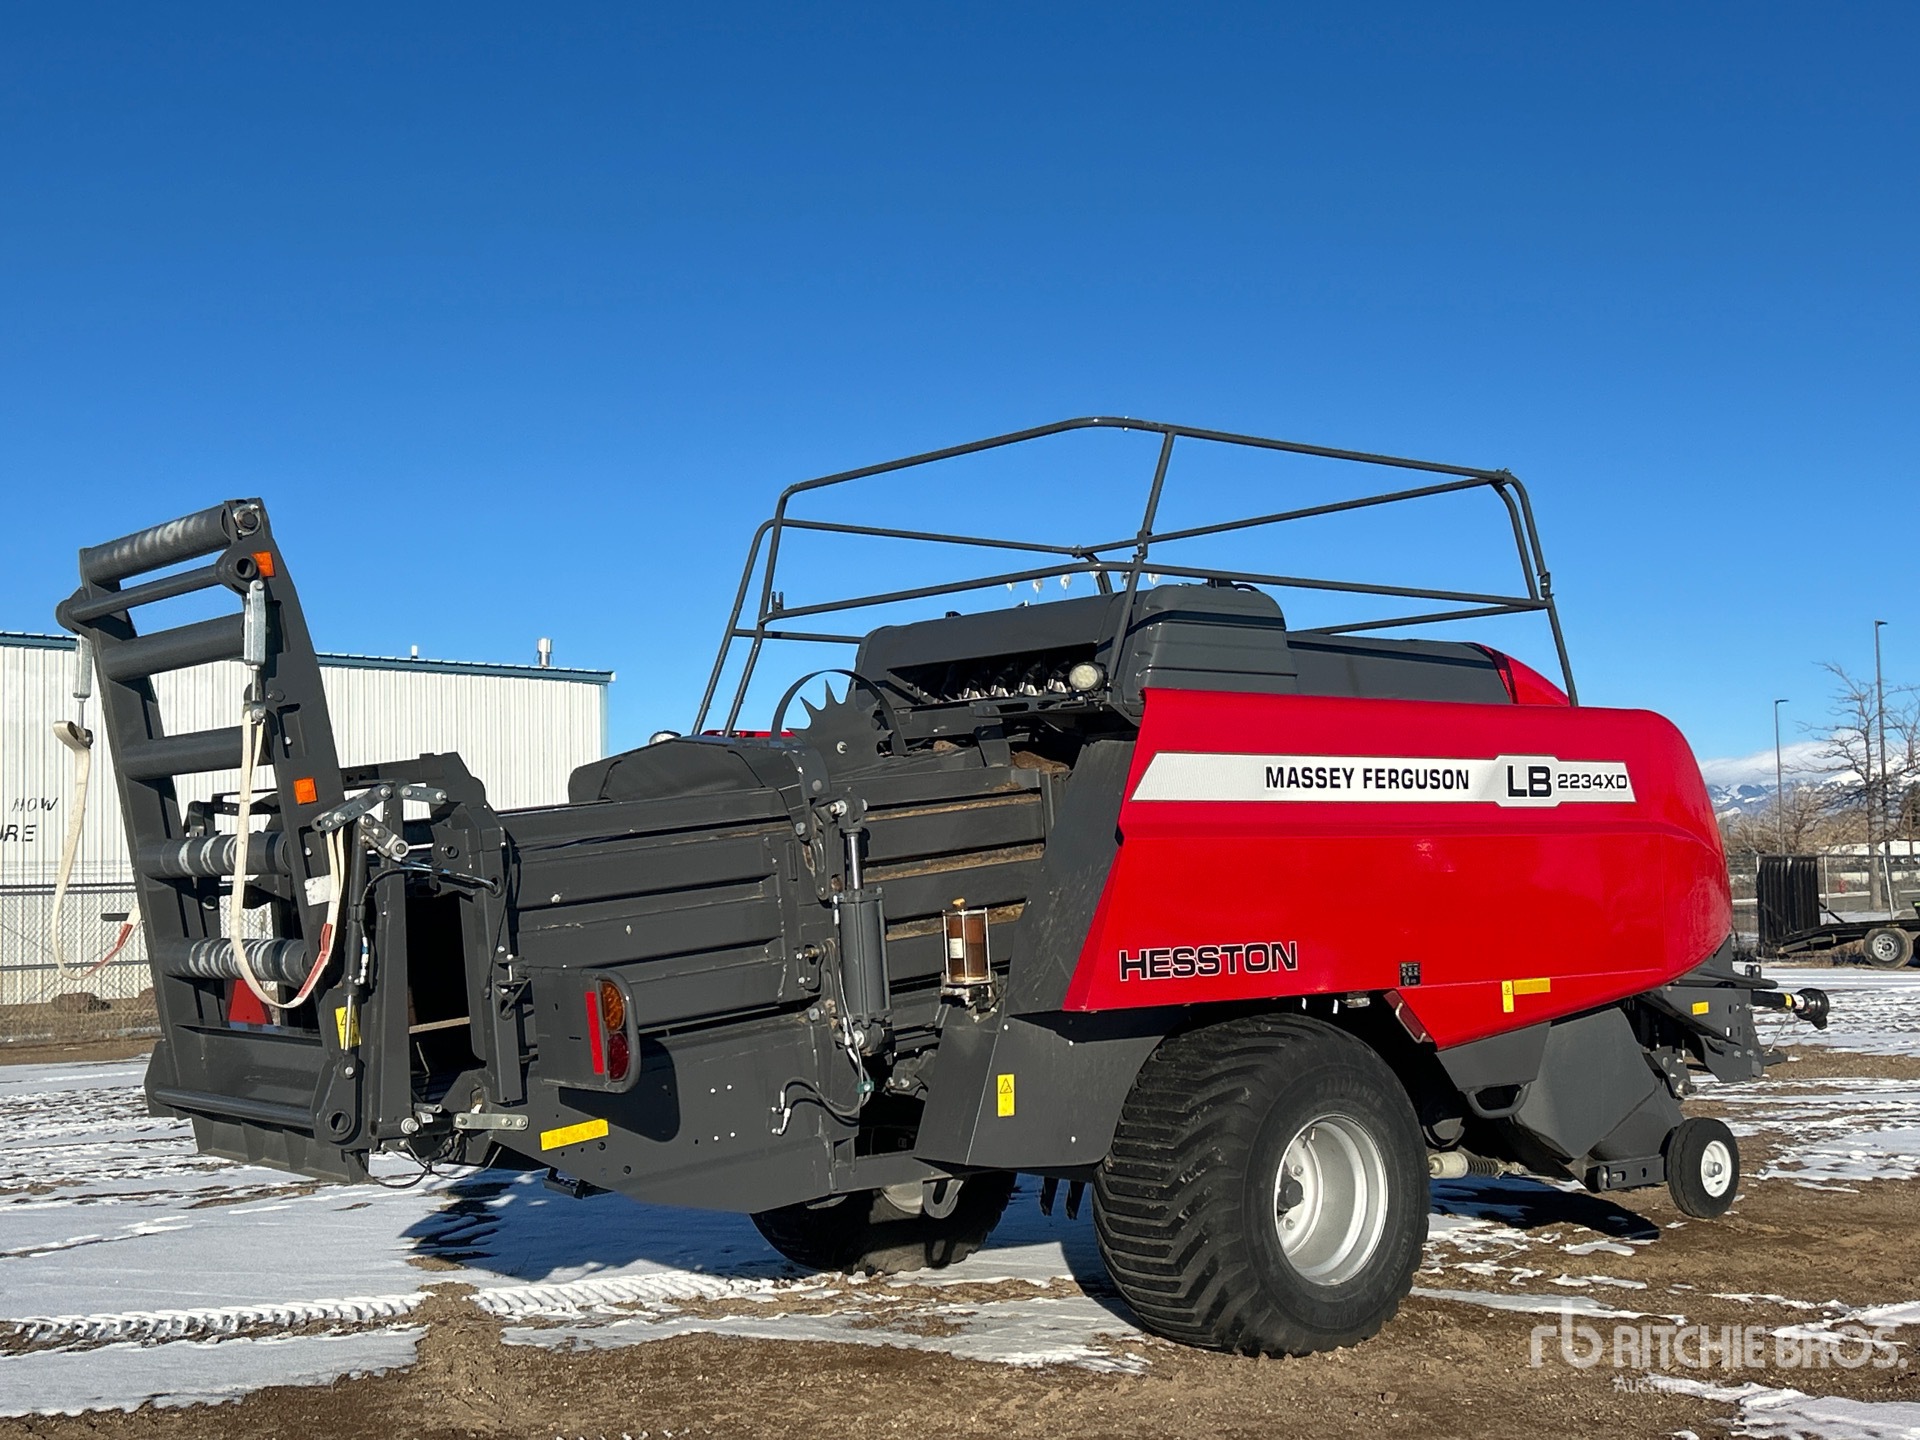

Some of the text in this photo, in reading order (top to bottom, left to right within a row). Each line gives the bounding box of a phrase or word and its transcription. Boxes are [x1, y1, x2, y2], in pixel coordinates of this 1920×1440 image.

[1265, 765, 1627, 797] MASSEY FERGUSON LB 2234XD
[1119, 941, 1298, 982] HESSTON
